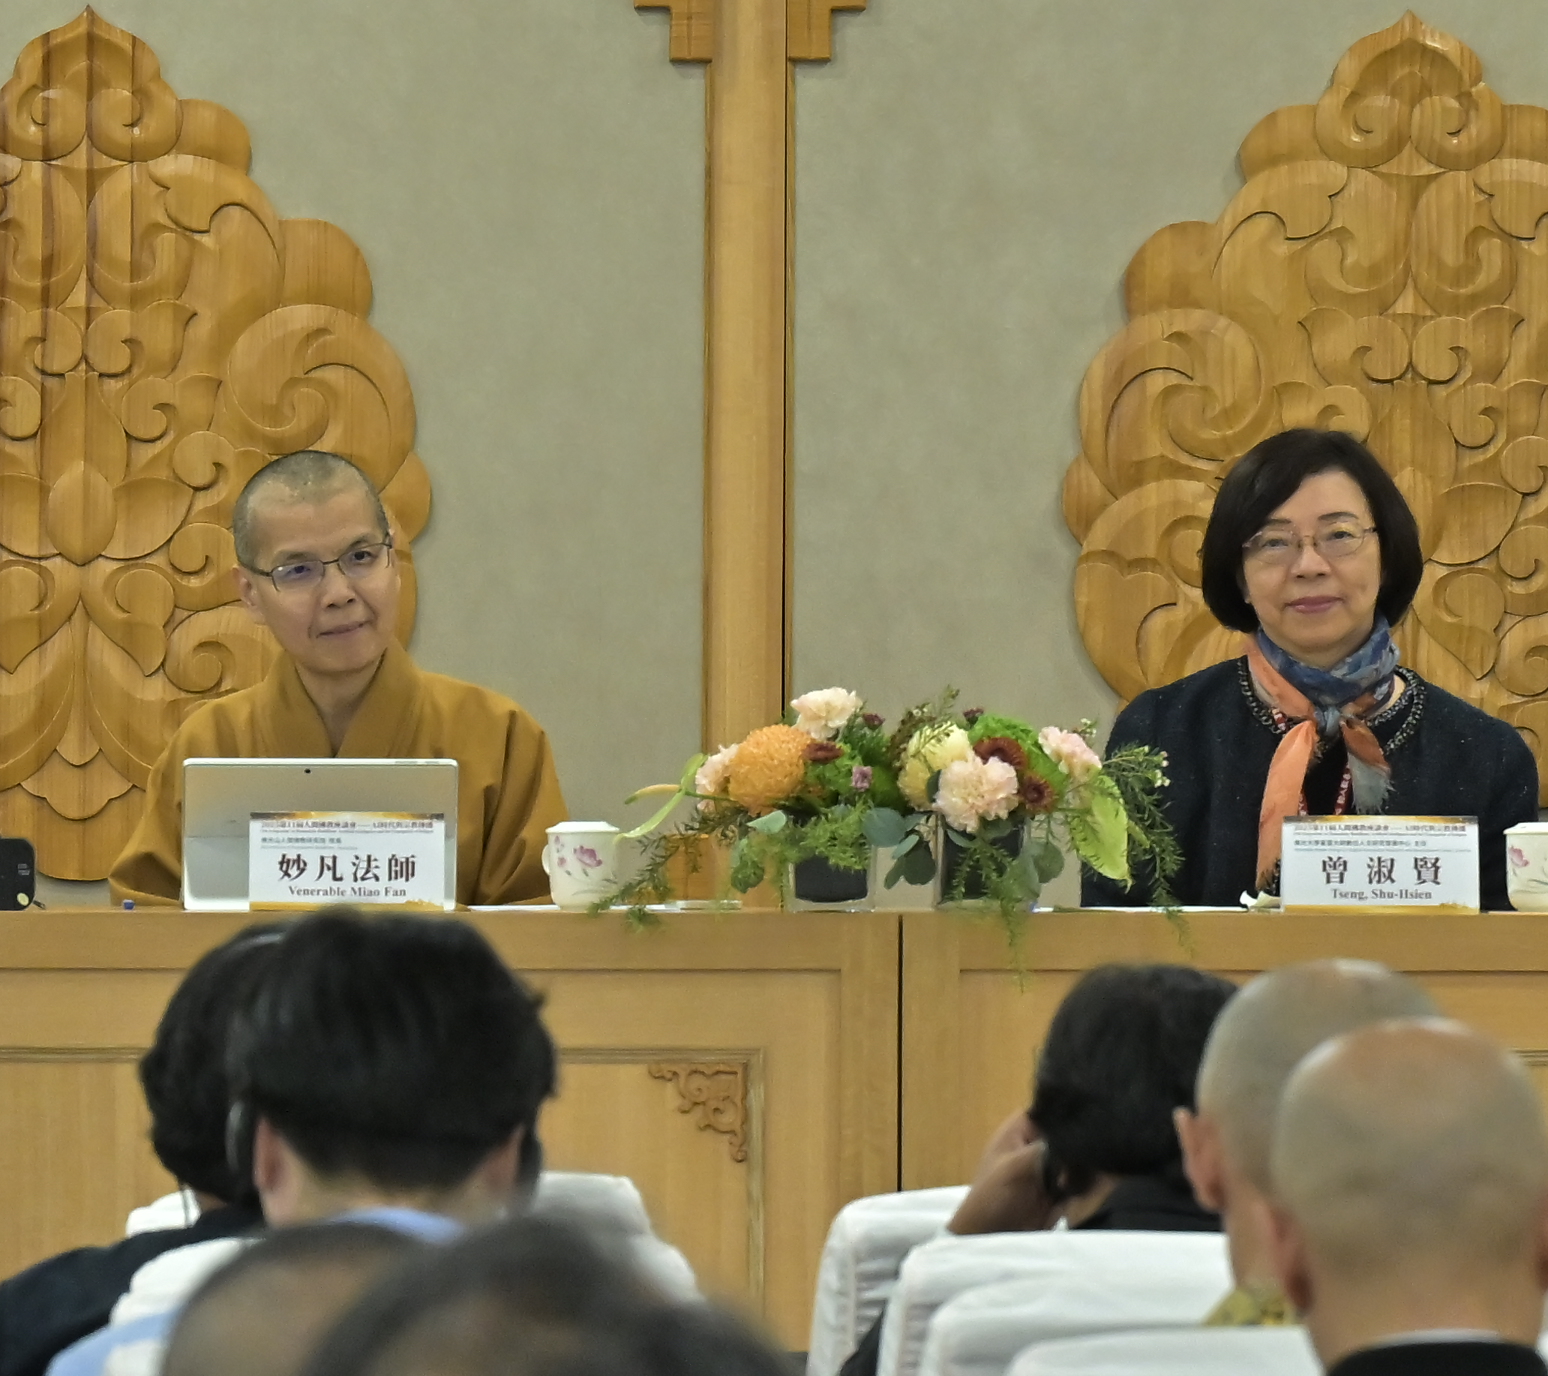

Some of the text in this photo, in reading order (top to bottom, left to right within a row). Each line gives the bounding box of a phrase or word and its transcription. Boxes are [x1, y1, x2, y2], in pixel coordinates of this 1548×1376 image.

[278, 853, 417, 883] 妙凡法師
[1321, 856, 1441, 886] 曾淑賢
[288, 885, 407, 897] Venerable Miao Fan
